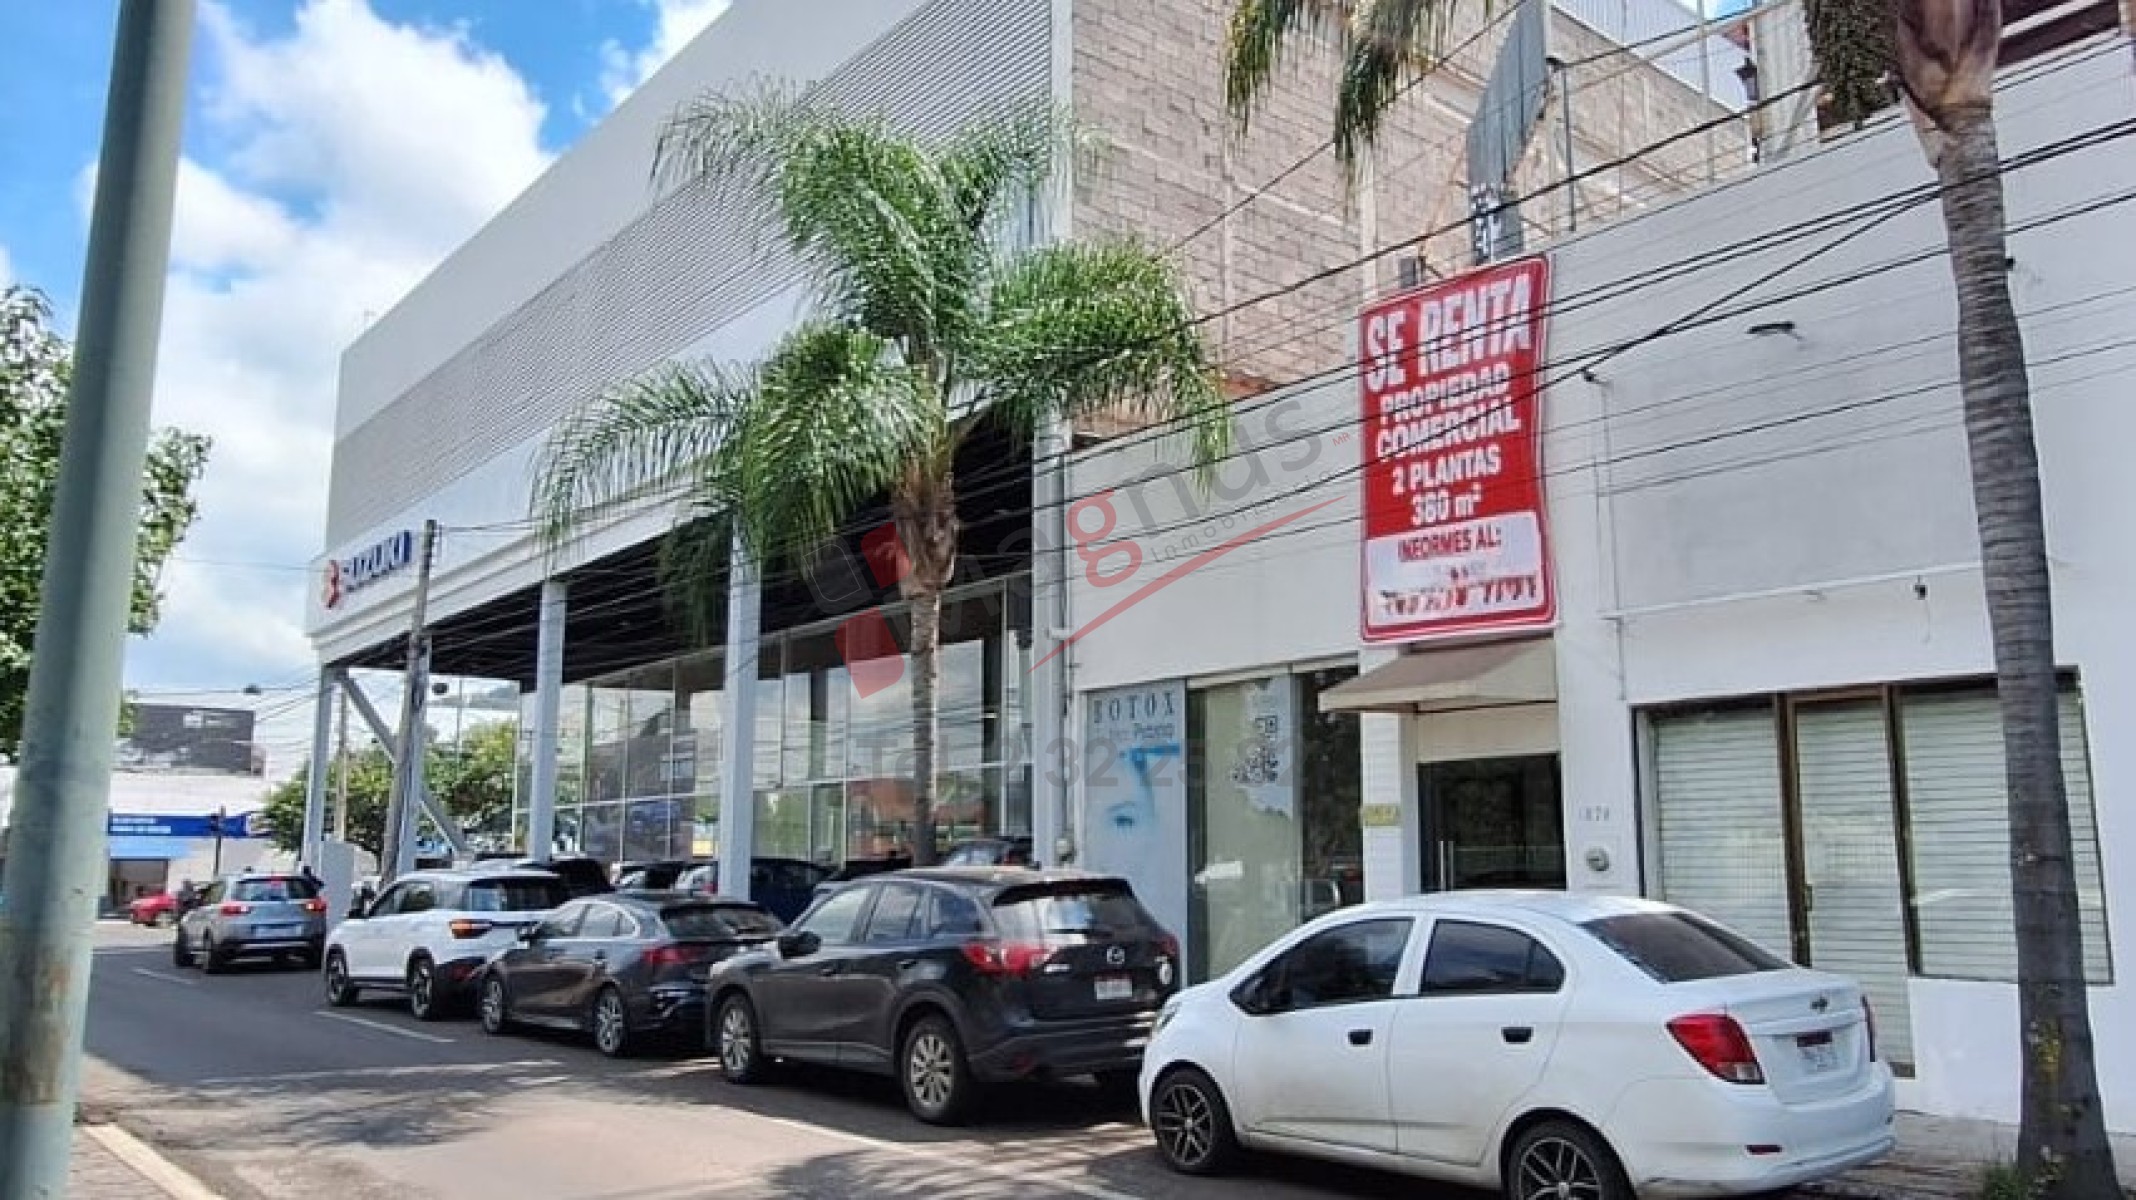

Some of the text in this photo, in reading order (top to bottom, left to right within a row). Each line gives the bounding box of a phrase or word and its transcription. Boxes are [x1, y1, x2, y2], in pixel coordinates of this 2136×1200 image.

[1367, 273, 1532, 392] SE RENTA
[1379, 361, 1512, 425] PROPIEDAD
[1377, 396, 1522, 464] COMERCIAL
[1392, 443, 1501, 496] 2 PLANTAS
[343, 530, 413, 594] SUZUKI
[1398, 523, 1502, 563] INFORMES AL:
